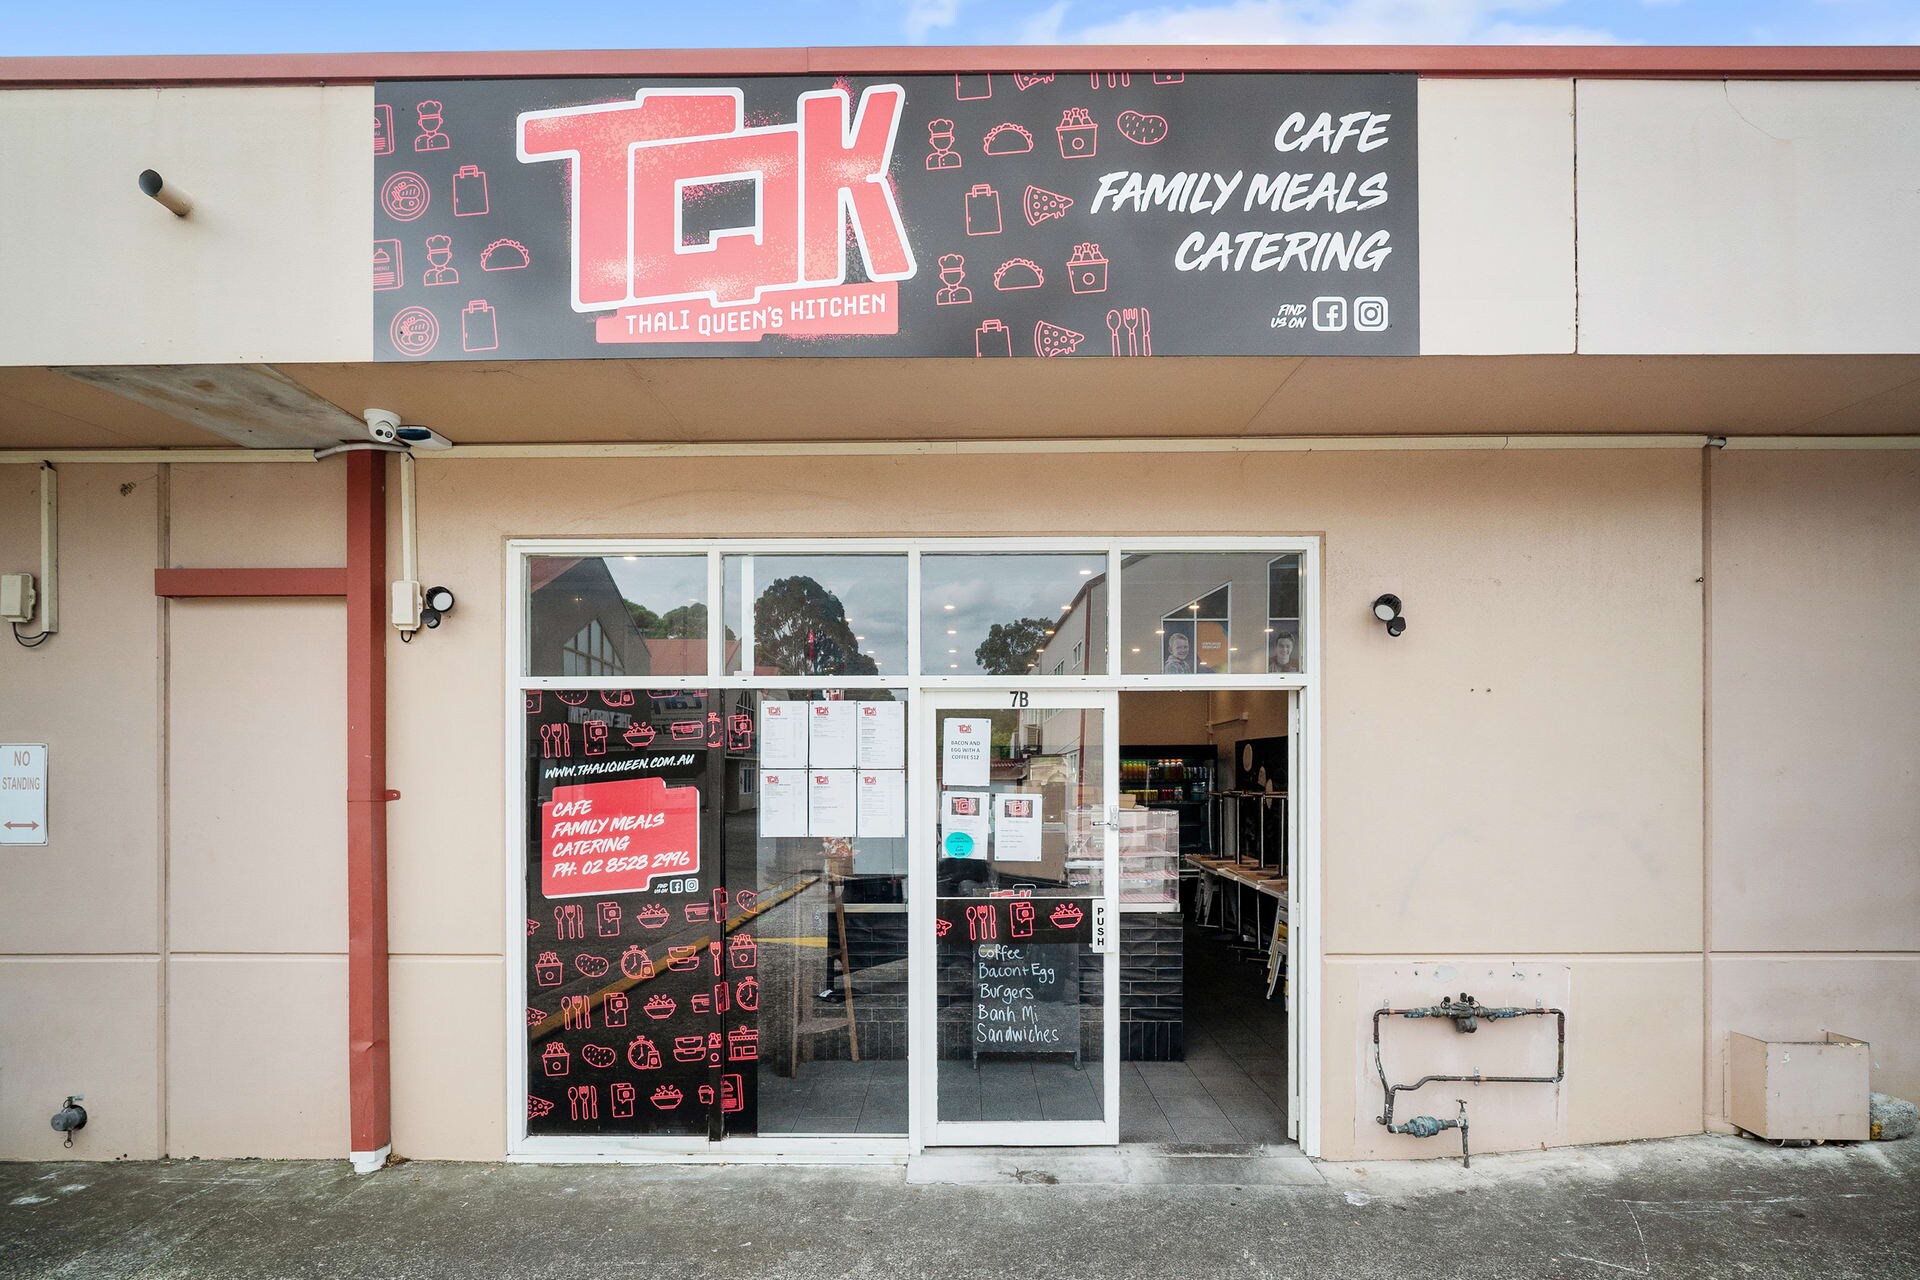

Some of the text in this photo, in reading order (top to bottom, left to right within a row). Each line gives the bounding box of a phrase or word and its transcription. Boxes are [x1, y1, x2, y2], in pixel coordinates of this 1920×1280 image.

[1273, 111, 1392, 155] CAFE
[1089, 170, 1389, 215] FAMILY MEALS
[1174, 229, 1393, 273] CATERING
[625, 293, 886, 337] THALI QUEEN'S KITCHEN
[1277, 303, 1307, 316] FIND
[1270, 316, 1308, 329] US ON
[1009, 690, 1029, 708] 7B
[14, 751, 31, 767] NO
[545, 754, 695, 779] WWW.THALIQUEEN.COM.AU
[2, 777, 40, 791] STANDING
[552, 800, 593, 818] CAFE
[551, 812, 665, 839] FAMILY MEALS
[552, 835, 631, 858] CATERING
[551, 851, 691, 878] PH: 02 8528 2996
[1097, 907, 1105, 946] PUSH
[978, 944, 1024, 961] Coffee
[1031, 963, 1055, 984] Egg
[979, 983, 1034, 1004] Burgers
[977, 1003, 1039, 1024] Banh Mi
[976, 1023, 1060, 1043] Sandwiches
